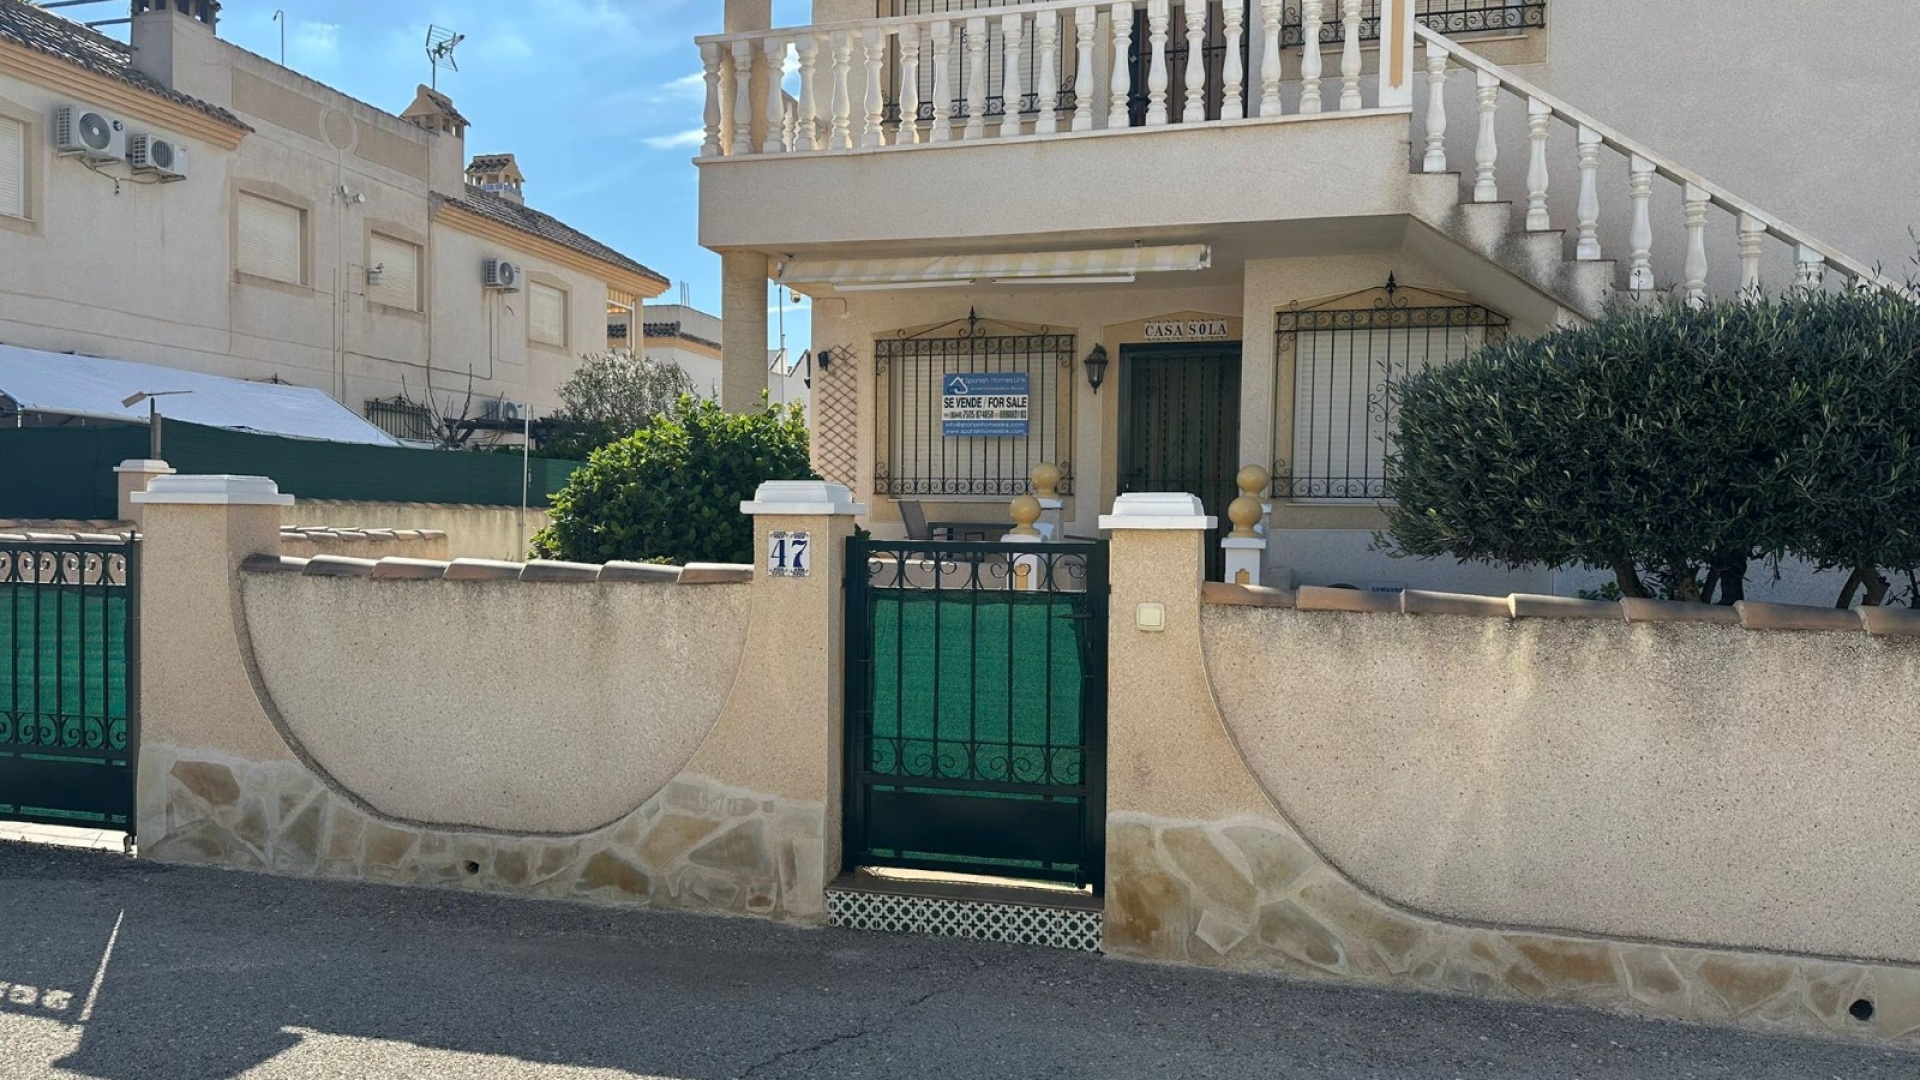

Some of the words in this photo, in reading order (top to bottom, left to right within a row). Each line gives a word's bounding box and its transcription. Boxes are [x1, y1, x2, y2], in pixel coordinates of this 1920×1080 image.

[1145, 324, 1183, 337] CASA
[1188, 323, 1227, 336] SOLA
[944, 397, 954, 408] SE
[956, 396, 982, 408] VENDE
[988, 396, 1005, 408] FOR
[1006, 396, 1027, 408] SALE
[770, 539, 808, 568] 47
